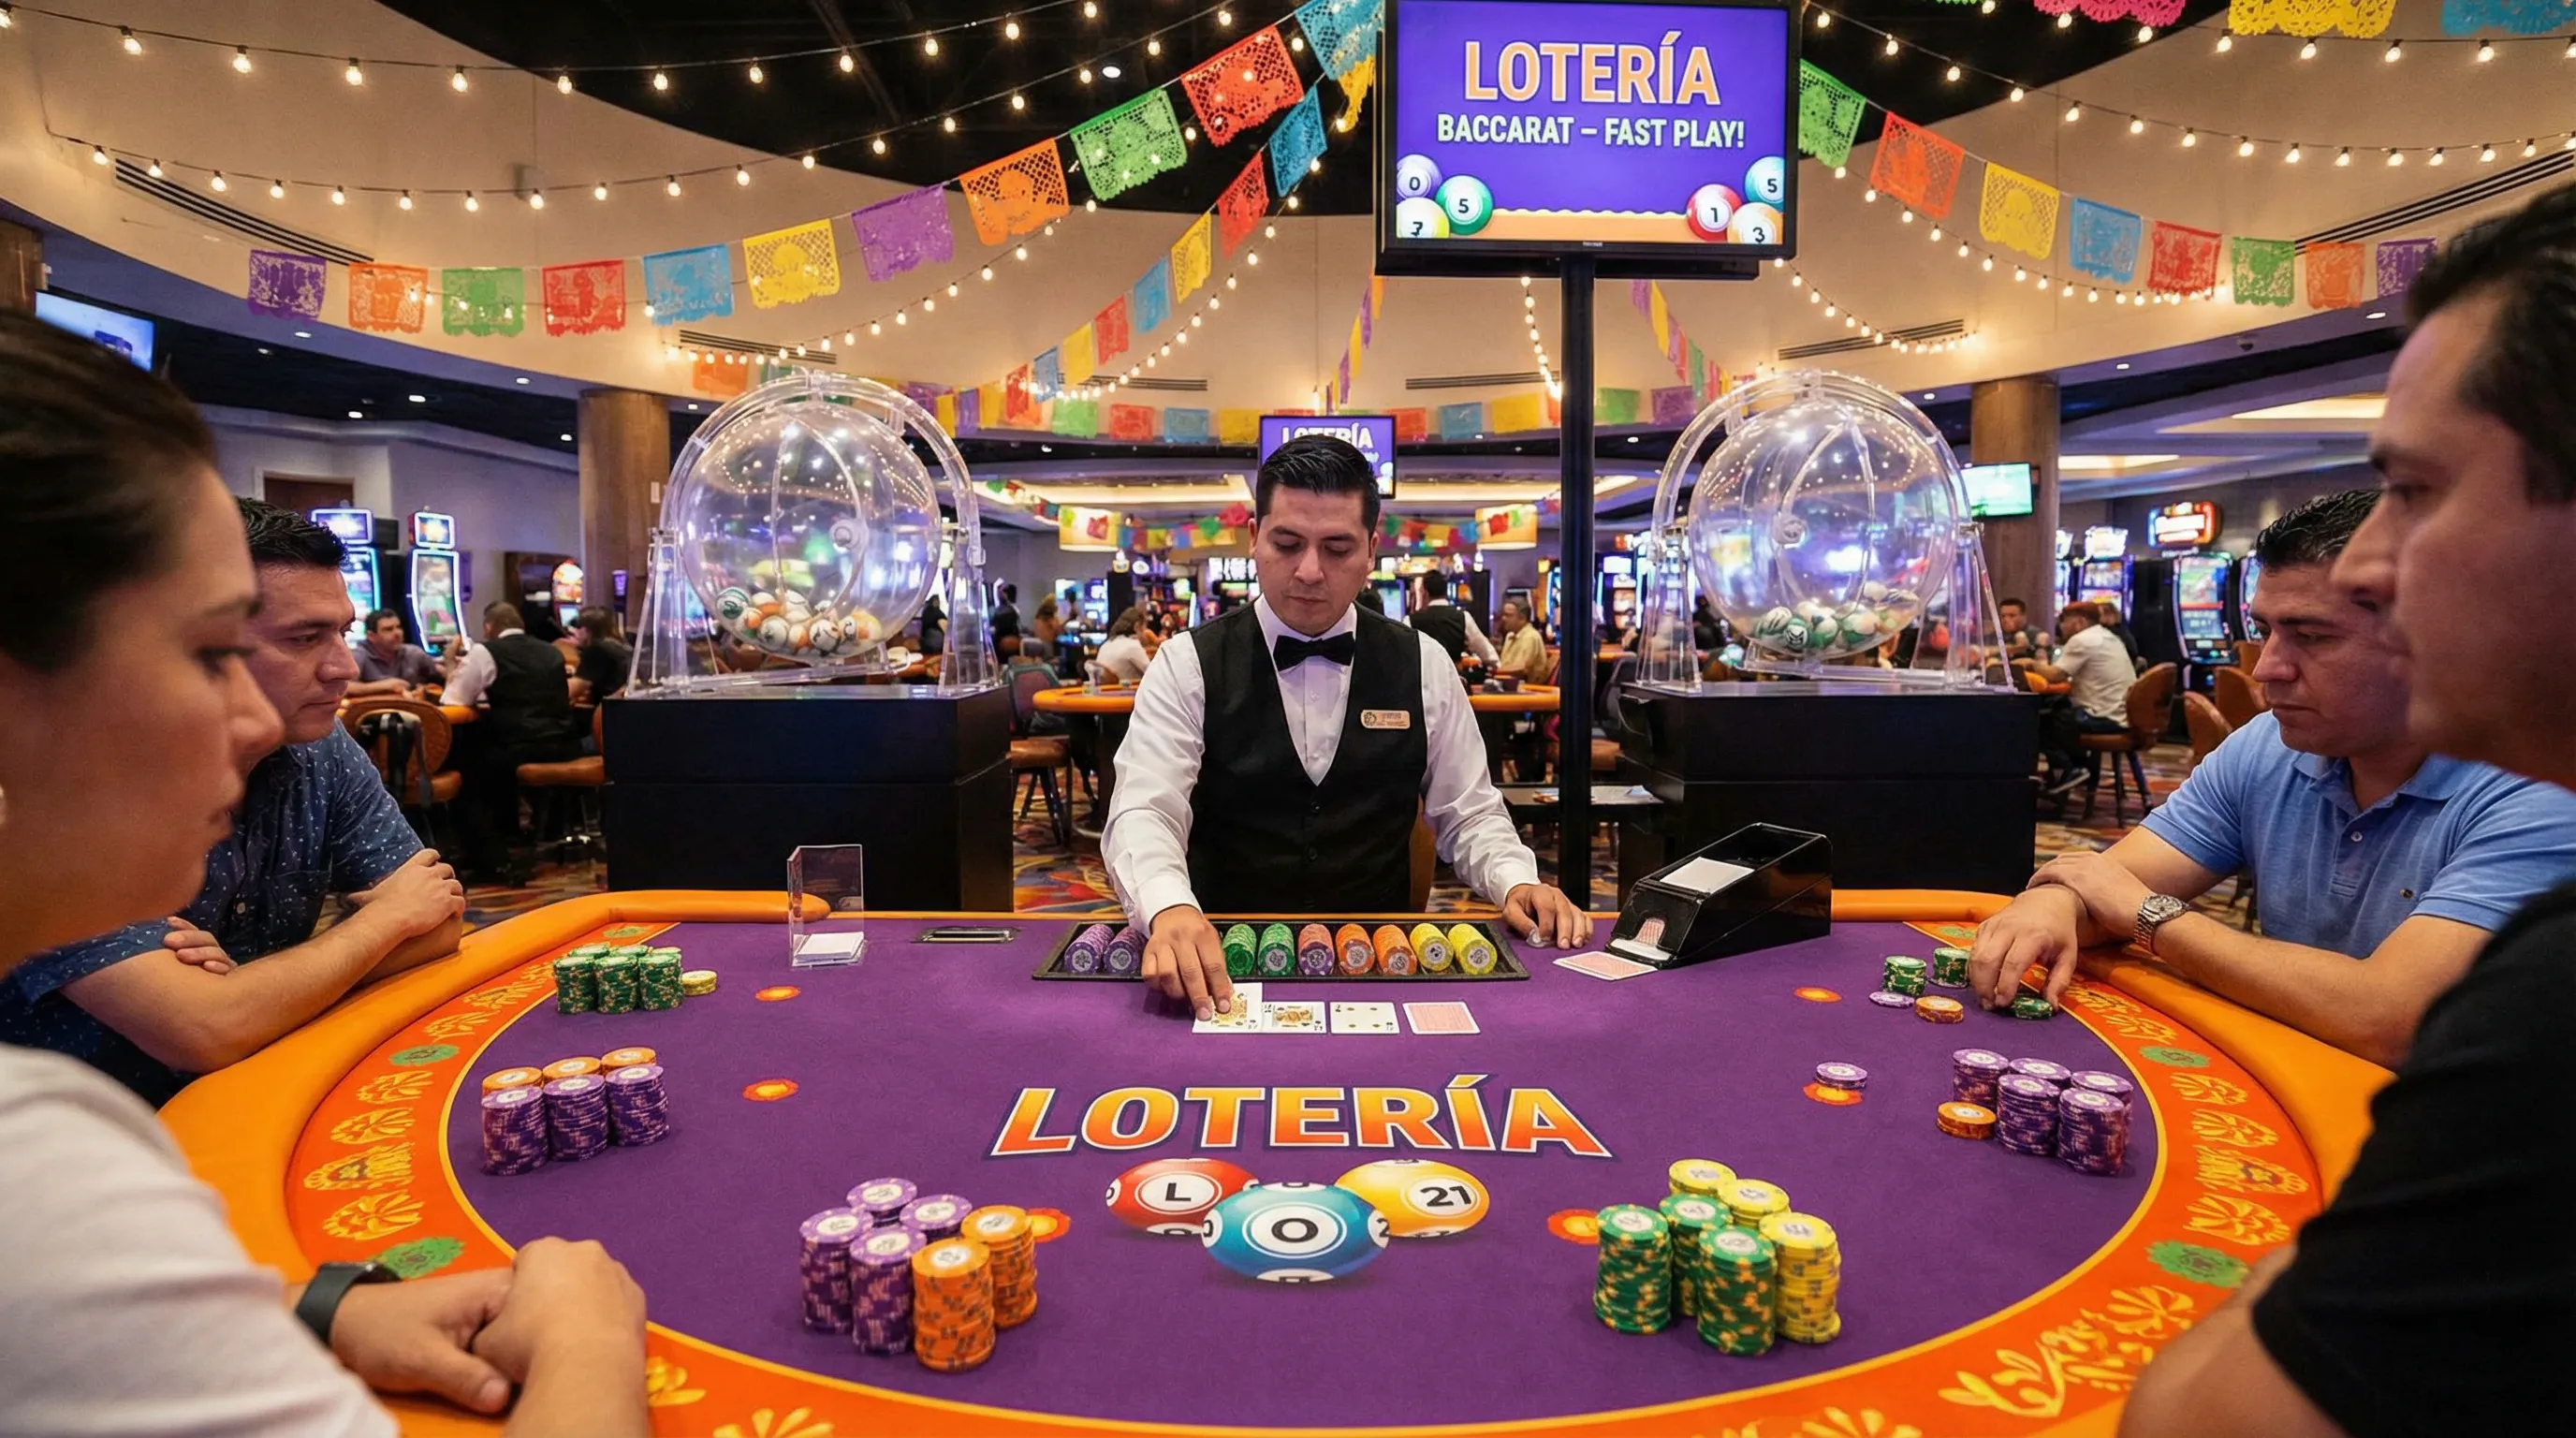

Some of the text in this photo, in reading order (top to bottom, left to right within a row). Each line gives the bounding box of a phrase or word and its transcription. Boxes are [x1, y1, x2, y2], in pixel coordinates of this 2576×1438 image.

[1464, 30, 1720, 106] LOTERÍA
[1437, 113, 1574, 145] BACCARAT
[1604, 118, 1667, 147] FAST
[1673, 120, 1745, 148] PLAY!
[1409, 176, 1421, 191] 0
[1765, 178, 1778, 193] 5
[1457, 198, 1470, 214] 5
[1710, 207, 1719, 223] 1
[1752, 227, 1765, 243] 3
[989, 1074, 1613, 1157] LOTERÍA
[1164, 1182, 1192, 1202] L
[1420, 1185, 1471, 1207] 21
